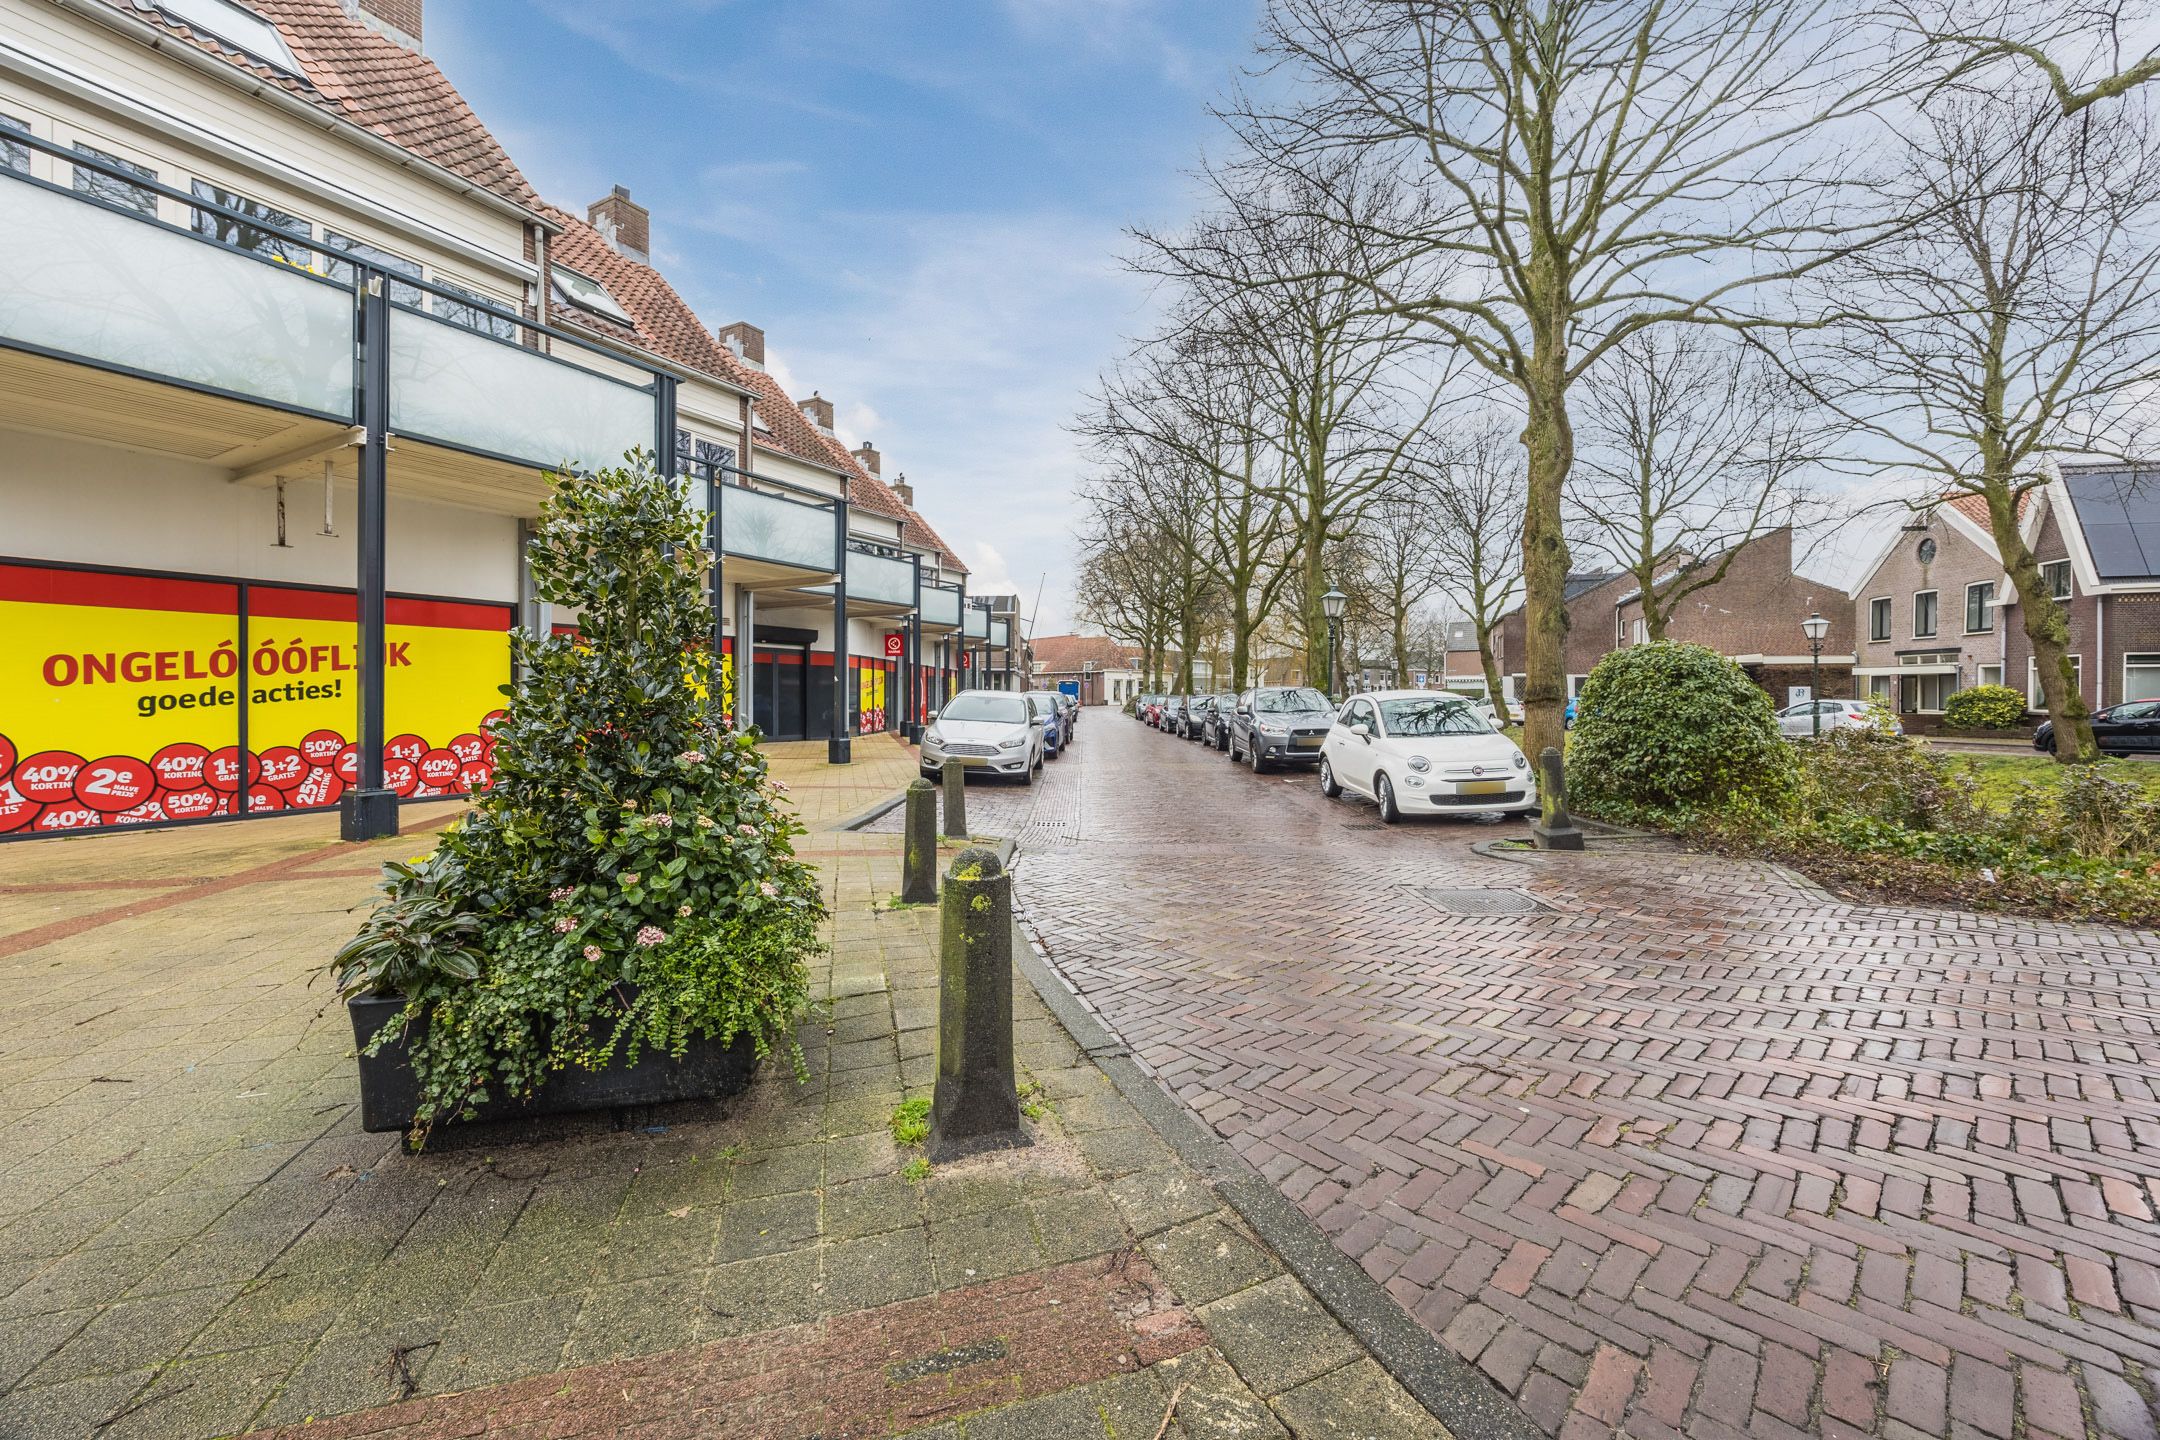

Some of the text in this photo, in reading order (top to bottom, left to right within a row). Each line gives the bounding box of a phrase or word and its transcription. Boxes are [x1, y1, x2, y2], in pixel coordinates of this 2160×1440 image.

[137, 679, 342, 717] goede acties!
[305, 739, 342, 753] 50%
[391, 743, 422, 758] 1+1
[452, 741, 482, 758] 3+2
[157, 755, 204, 772] 40%
[213, 758, 240, 776] 1+
[261, 755, 301, 777] 3+2
[341, 753, 357, 772] 2
[422, 759, 457, 773] 40%
[22, 764, 79, 783] 40%
[84, 768, 134, 795] 2e
[164, 770, 203, 779] KORTING
[217, 773, 240, 782] GRAT
[460, 768, 488, 786] 1+1
[30, 781, 73, 791] KORTIN
[113, 784, 140, 793] HALVE
[296, 767, 324, 805] 25%
[316, 772, 332, 802] KORTING
[168, 792, 213, 809] 50%
[174, 804, 209, 814] KORTING
[41, 809, 101, 828] 40%
